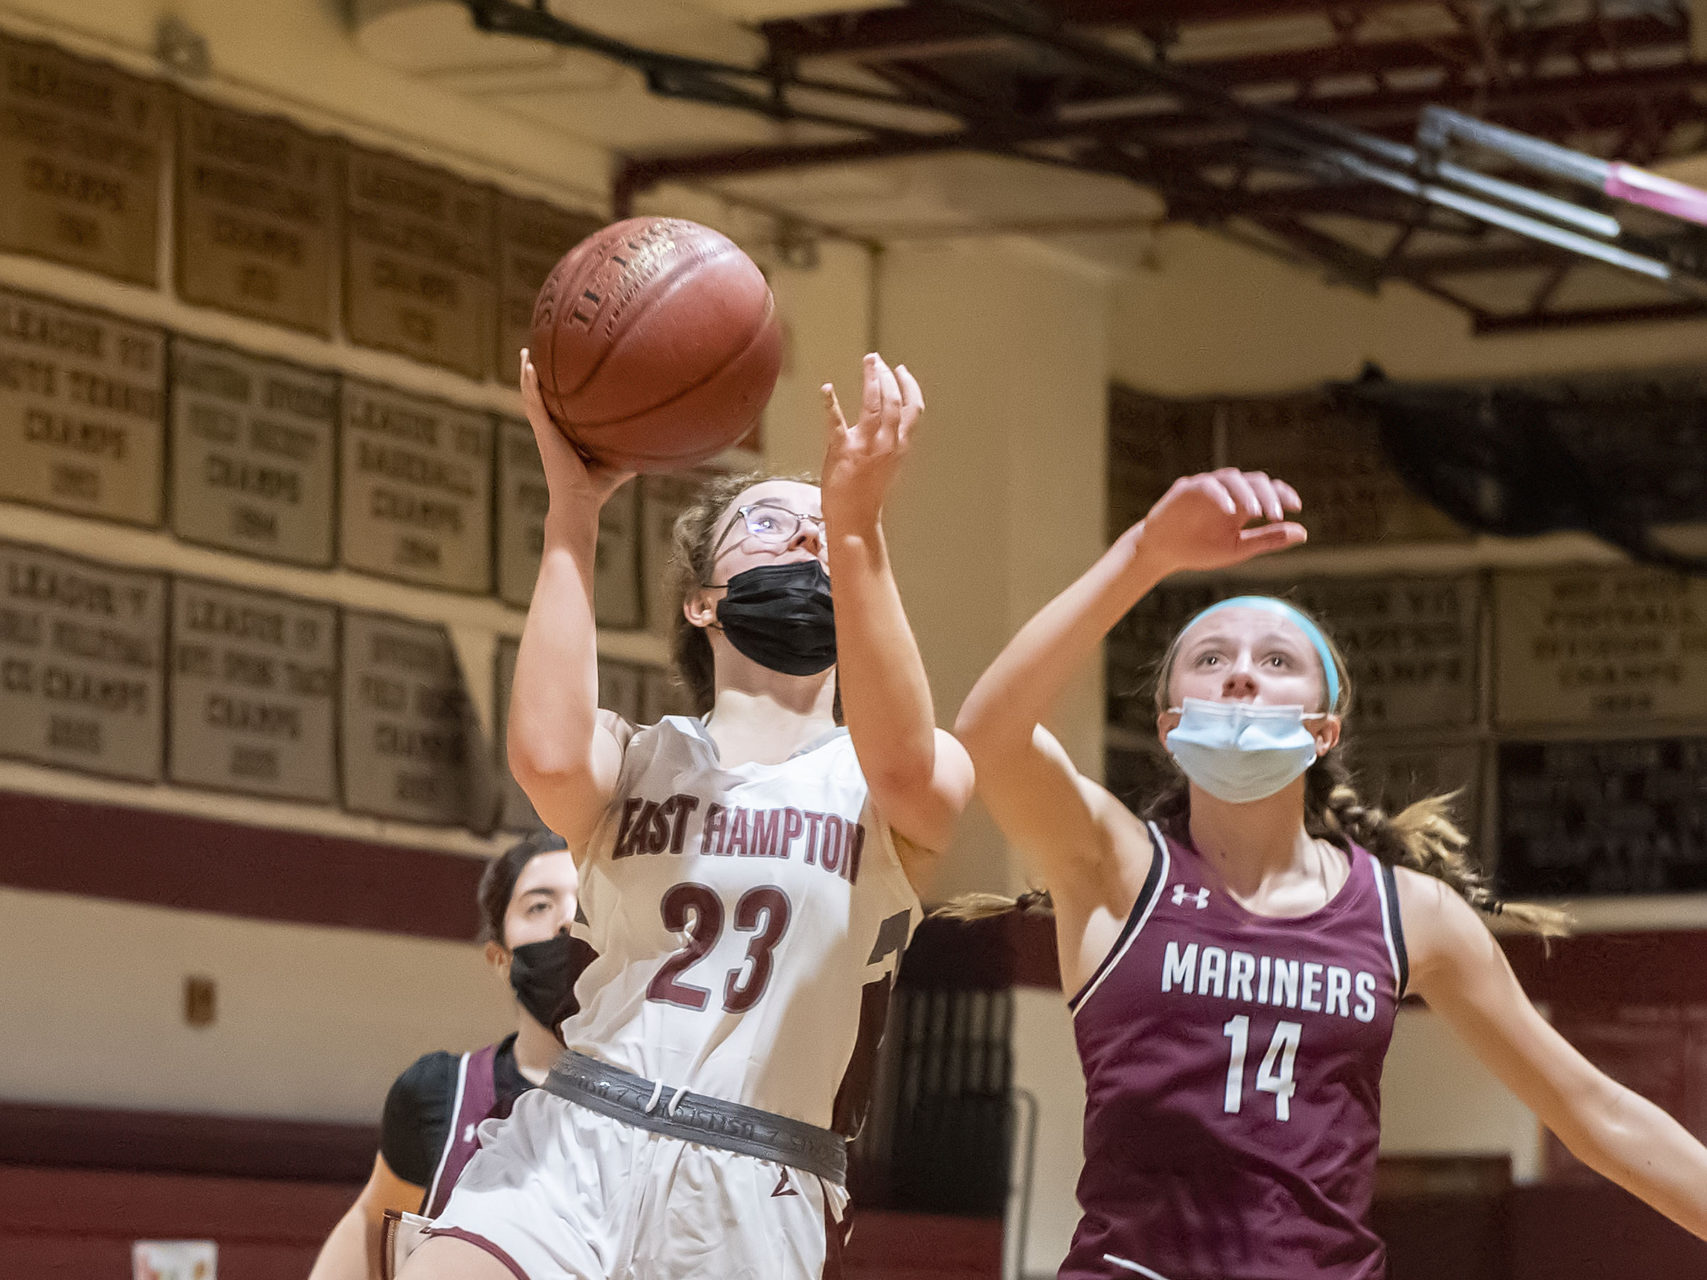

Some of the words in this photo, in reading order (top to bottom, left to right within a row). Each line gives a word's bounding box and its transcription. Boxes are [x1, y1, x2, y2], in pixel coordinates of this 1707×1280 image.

[612, 793, 698, 860] EAST
[701, 803, 866, 886] HAMPTON
[645, 880, 792, 1016] 23
[1161, 941, 1376, 1023] MARINERS
[1222, 1014, 1304, 1123] 14
